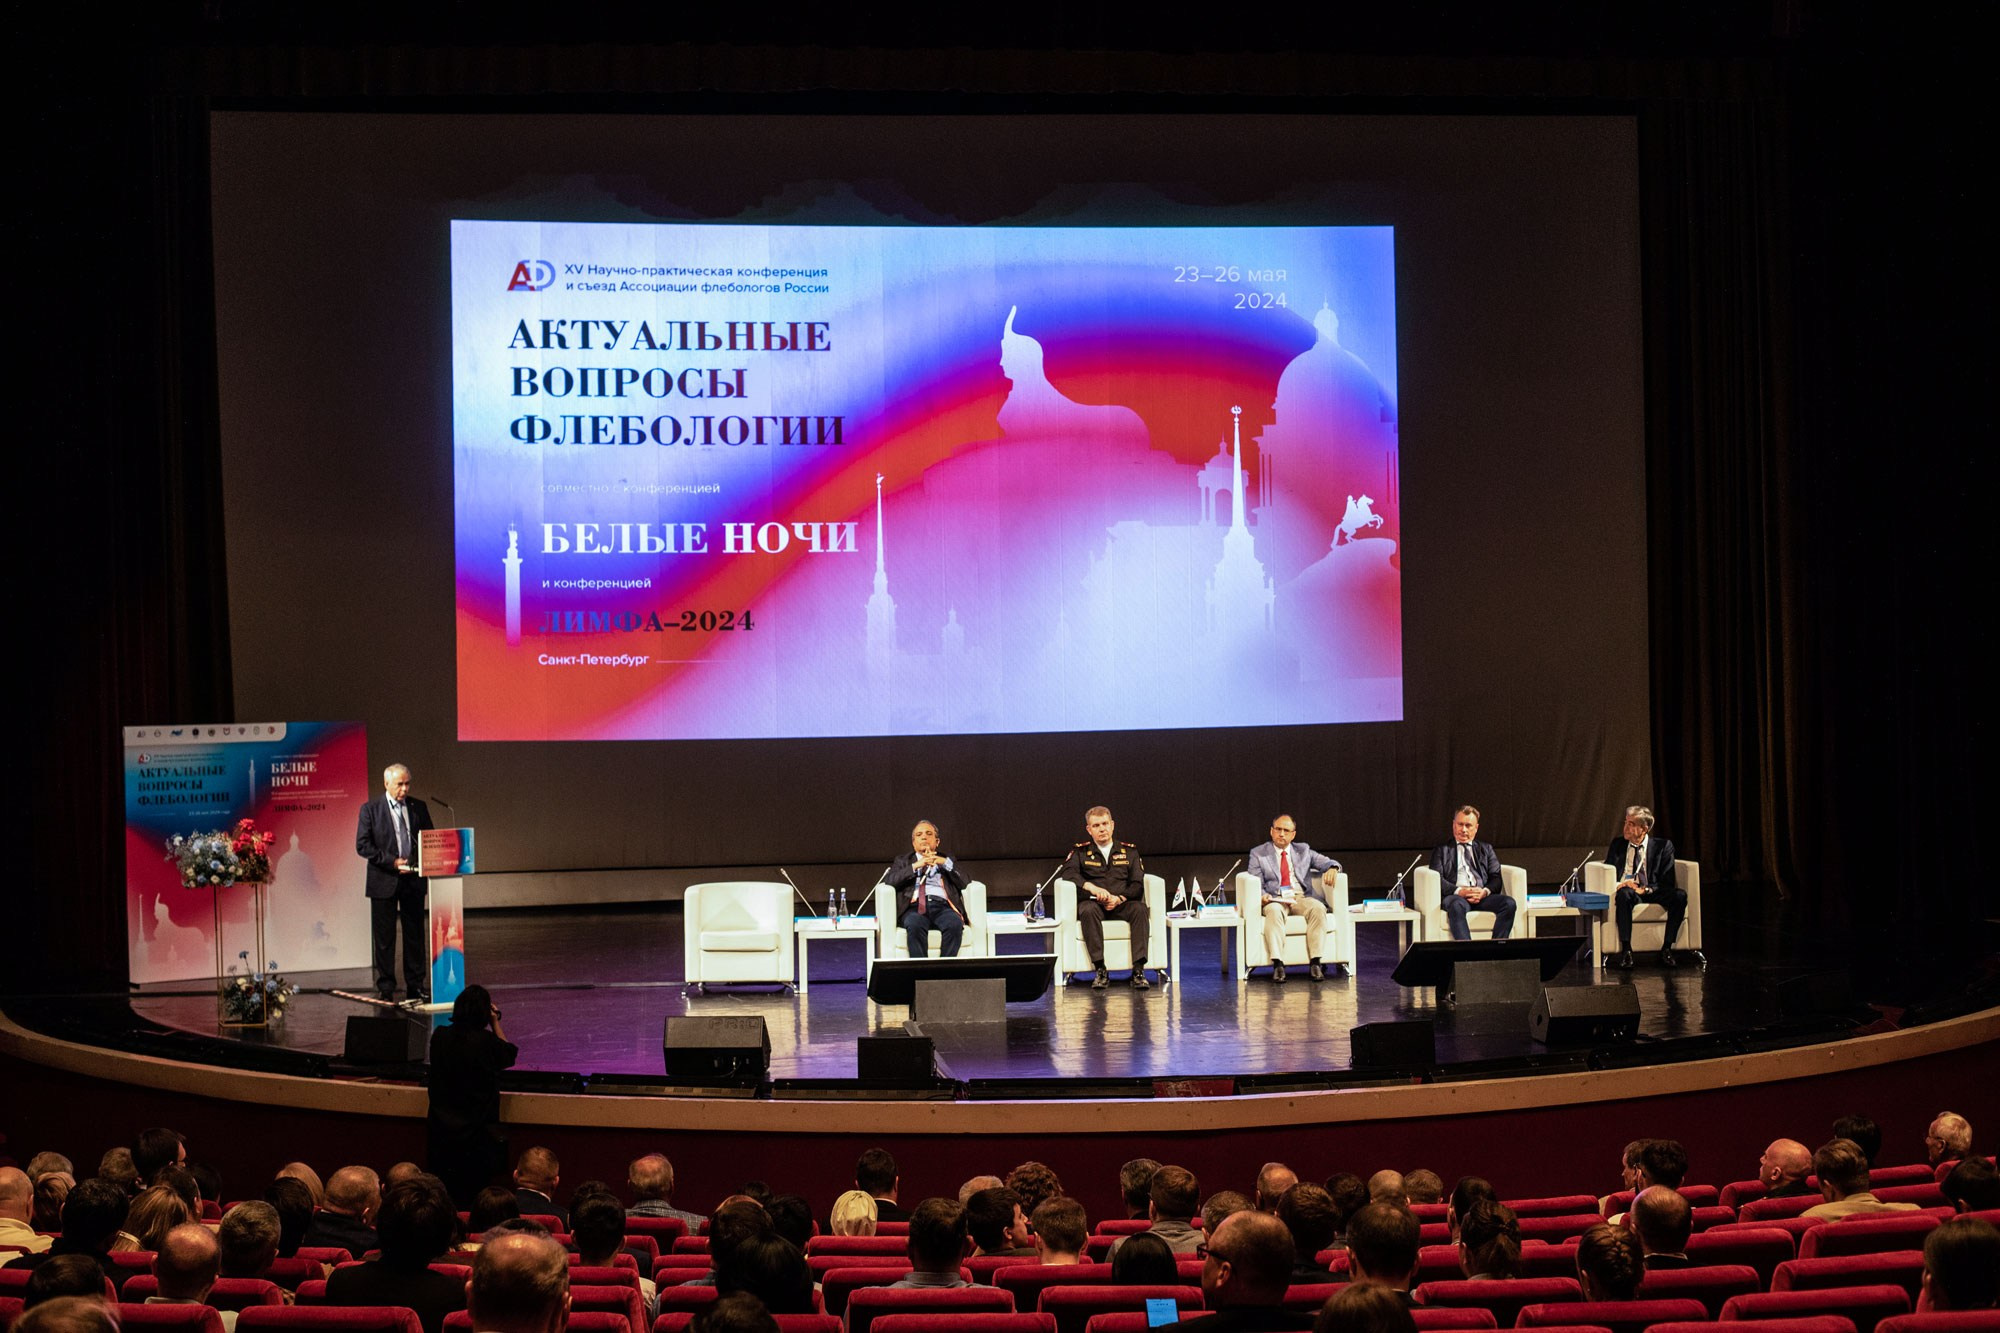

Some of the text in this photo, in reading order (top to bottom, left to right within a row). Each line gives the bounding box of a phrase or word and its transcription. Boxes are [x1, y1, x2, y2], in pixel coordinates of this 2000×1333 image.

[565, 263, 828, 279] XV Научно-практическая конференция
[1248, 268, 1287, 282] мая
[566, 281, 829, 294] и съезд Ассоциации флебологов России
[1234, 292, 1287, 309] 2024
[507, 319, 831, 351] АКТУАЛЬНЫЕ
[510, 366, 748, 399] ВОПРОСЫ
[510, 414, 846, 446] ФЛЕБОЛОГИИ
[540, 482, 721, 496] совместно с конференцией
[541, 521, 859, 554] БЕЛЫЕ НОЧИ
[542, 577, 651, 590] и конференцией
[538, 654, 650, 668] Санкт-Петербург
[138, 765, 227, 778] АКТУАЛЬНЫЕ
[271, 761, 317, 774] БЕЛЫЕ
[138, 779, 203, 792] ВОПРОСЫ
[271, 775, 309, 787] НОЧИ
[138, 792, 230, 806] ФЛЕБОЛОГИИ
